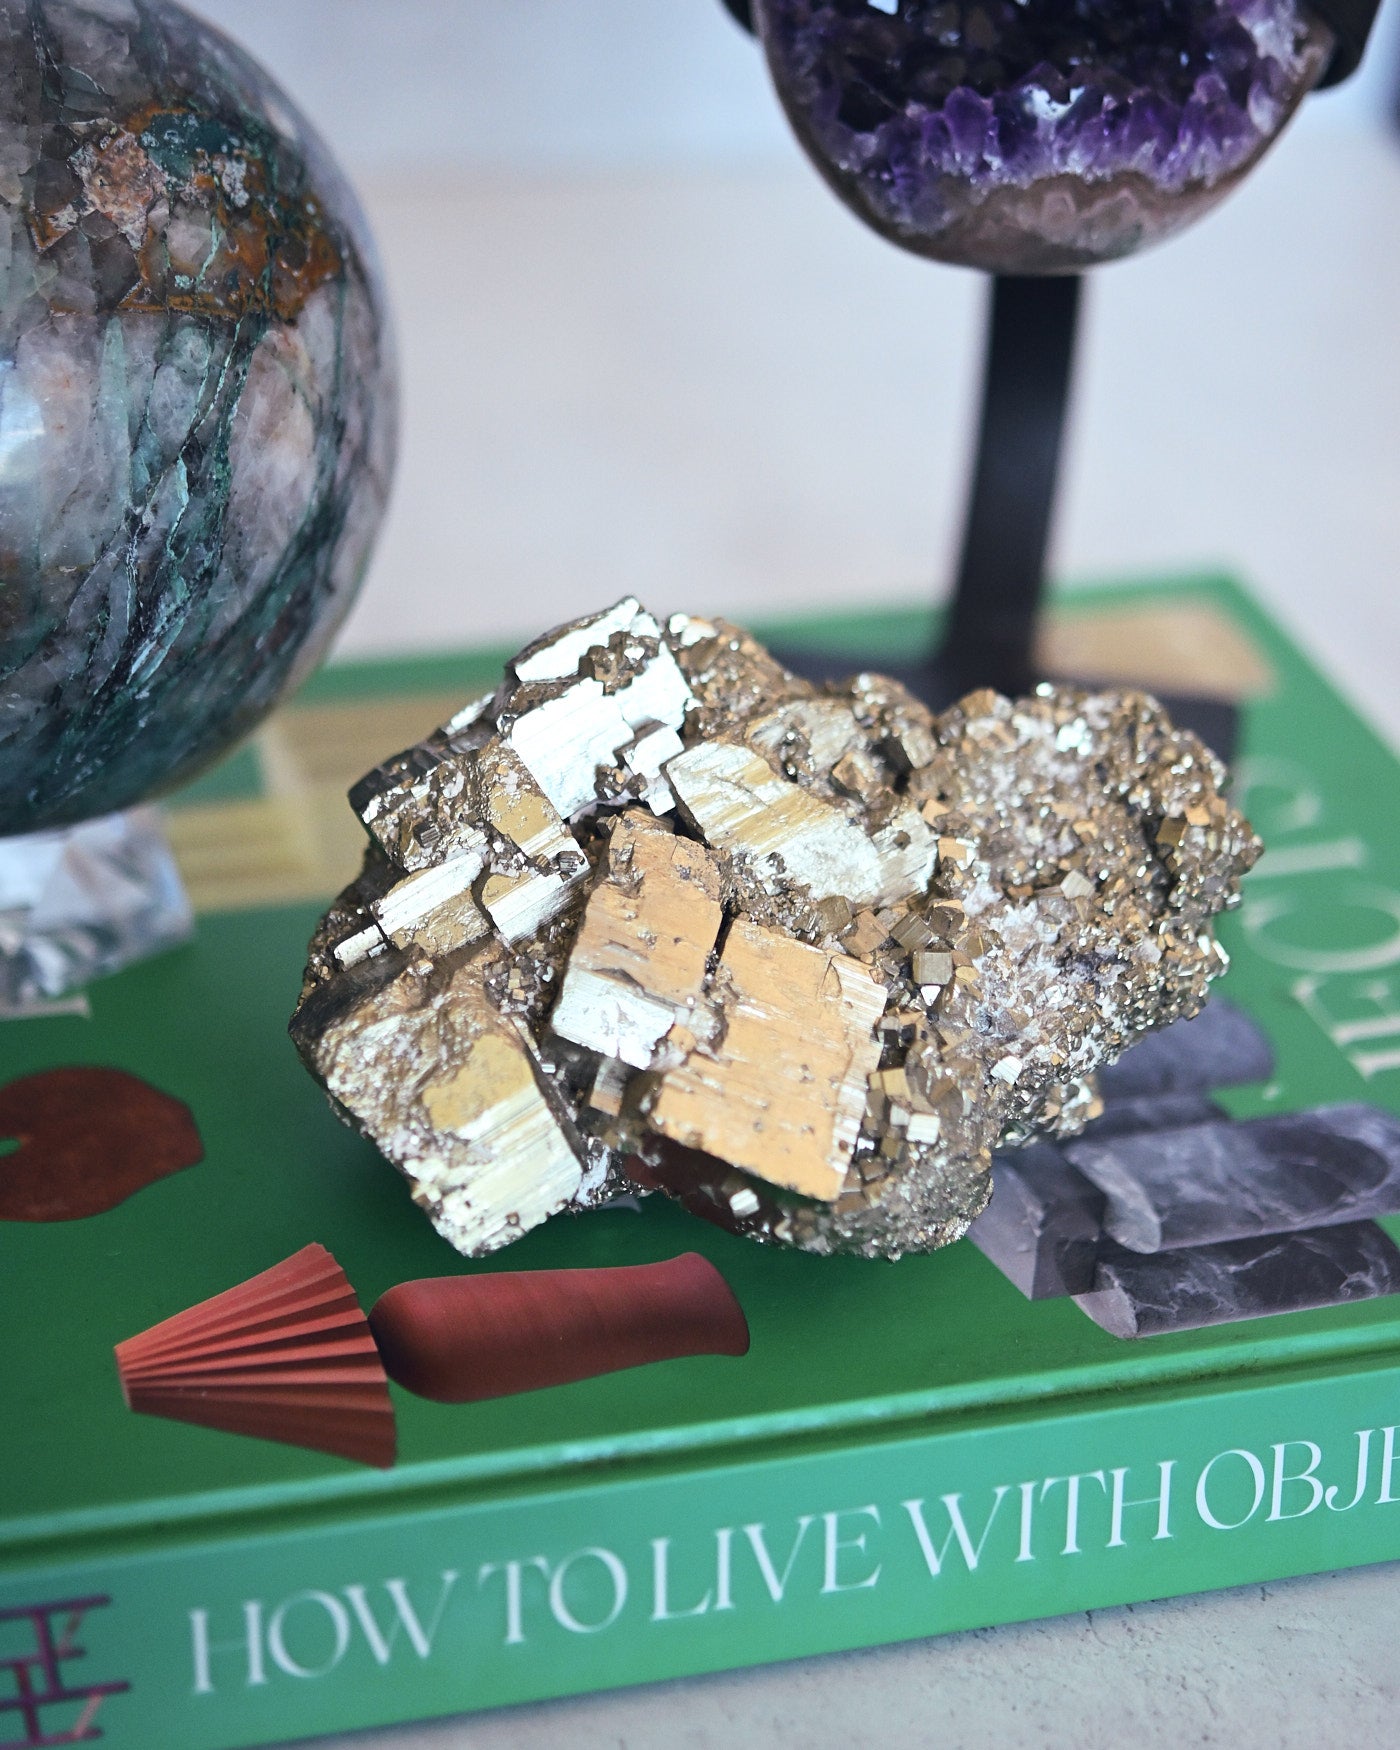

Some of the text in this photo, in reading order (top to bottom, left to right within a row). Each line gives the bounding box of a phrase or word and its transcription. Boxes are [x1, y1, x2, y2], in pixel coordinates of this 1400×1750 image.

[188, 1568, 460, 1694] HOW
[477, 1546, 628, 1645] TO
[650, 1503, 883, 1622] LIVE
[901, 1459, 1178, 1577] WITH
